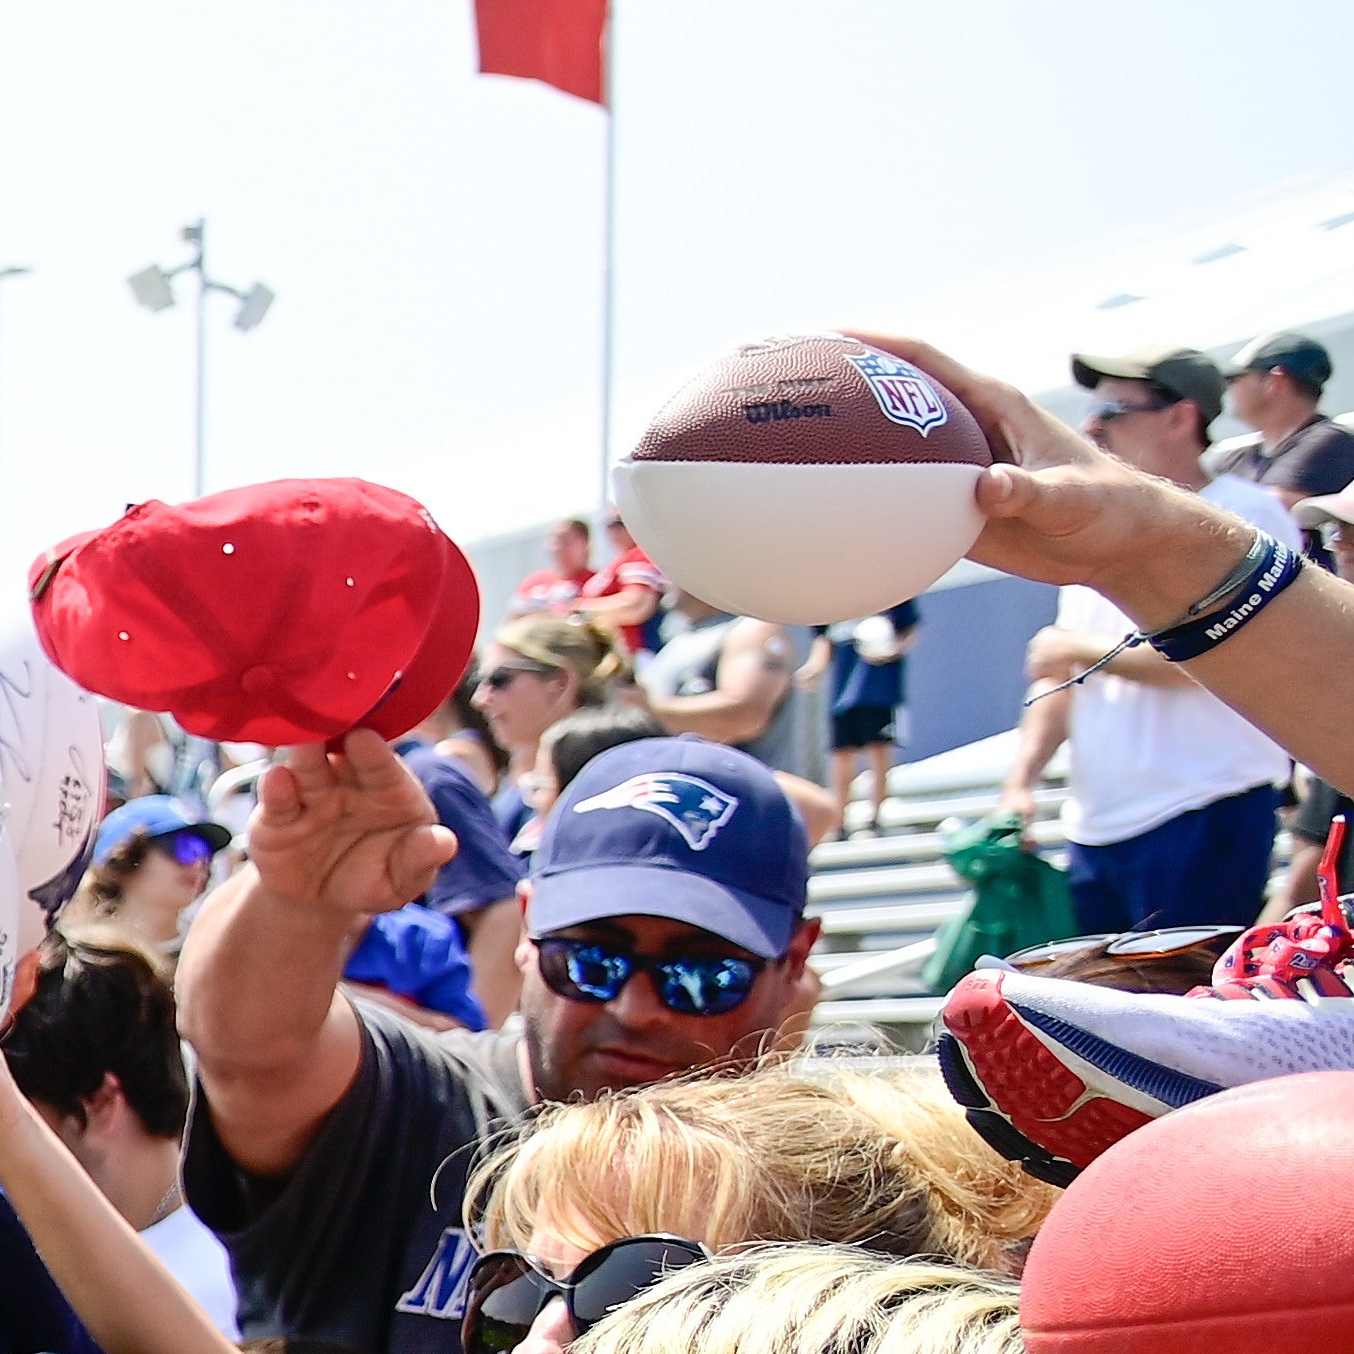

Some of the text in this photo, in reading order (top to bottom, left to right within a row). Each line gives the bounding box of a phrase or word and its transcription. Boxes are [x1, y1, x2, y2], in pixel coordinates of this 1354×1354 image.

[744, 400, 833, 424] Wilson
[877, 377, 939, 420] NFL
[1204, 592, 1263, 641] Maine
